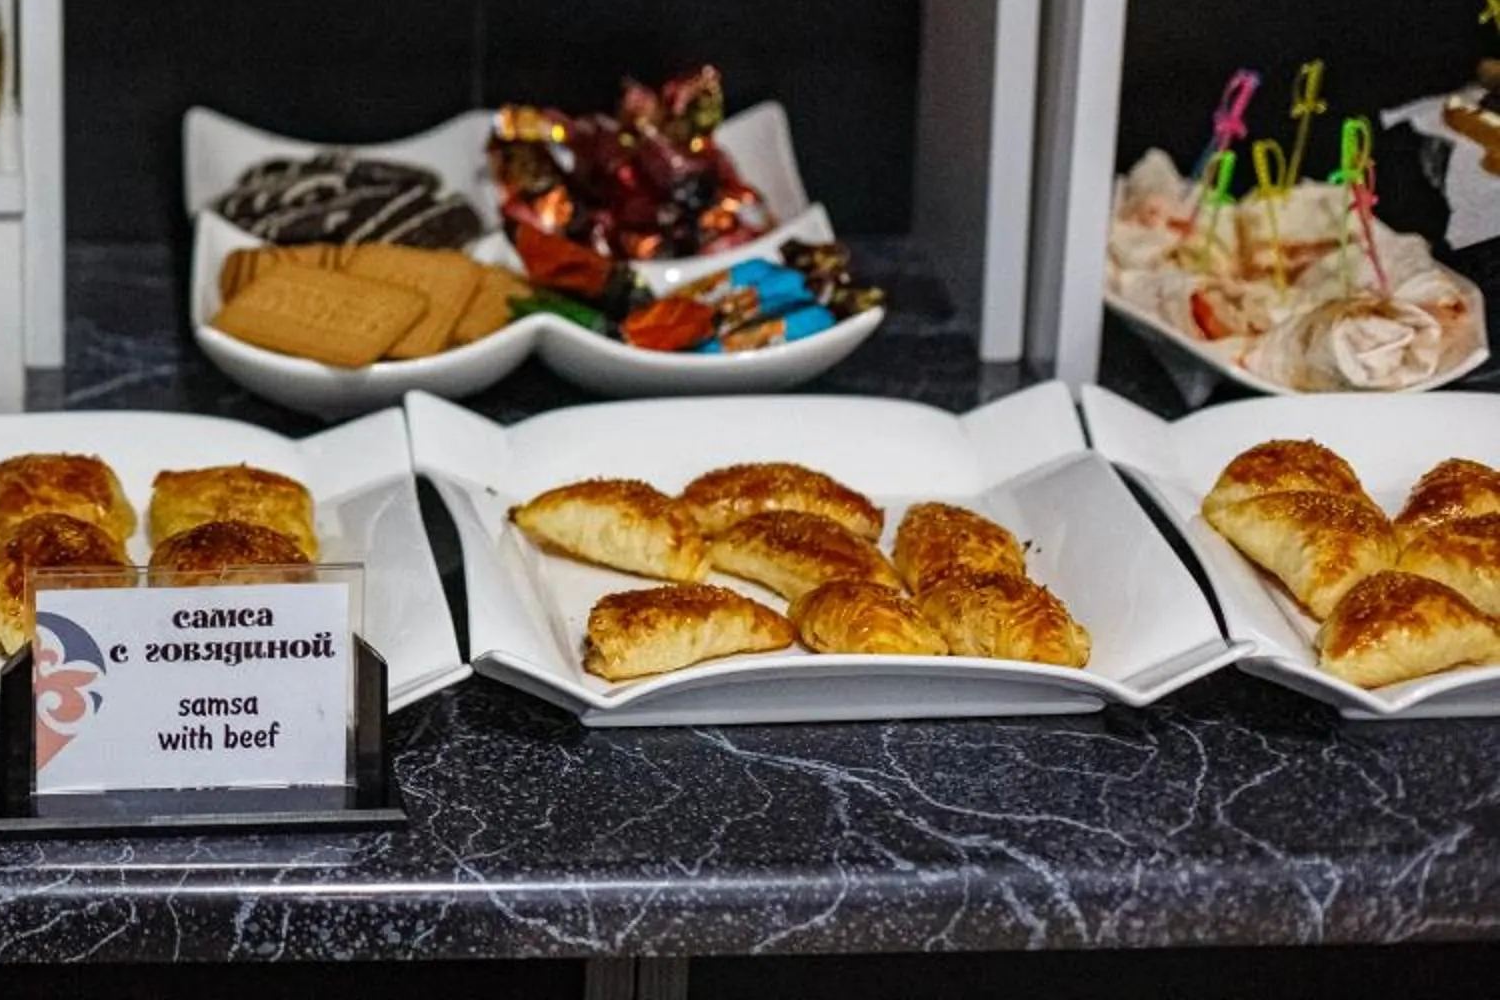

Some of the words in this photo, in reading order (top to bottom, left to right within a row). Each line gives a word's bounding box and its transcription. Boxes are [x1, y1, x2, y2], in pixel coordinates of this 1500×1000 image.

[172, 606, 274, 628] самса
[109, 642, 129, 664] с
[145, 631, 336, 666] говядиной
[179, 695, 259, 717] samsa
[157, 725, 213, 751] with
[223, 722, 281, 750] beef
